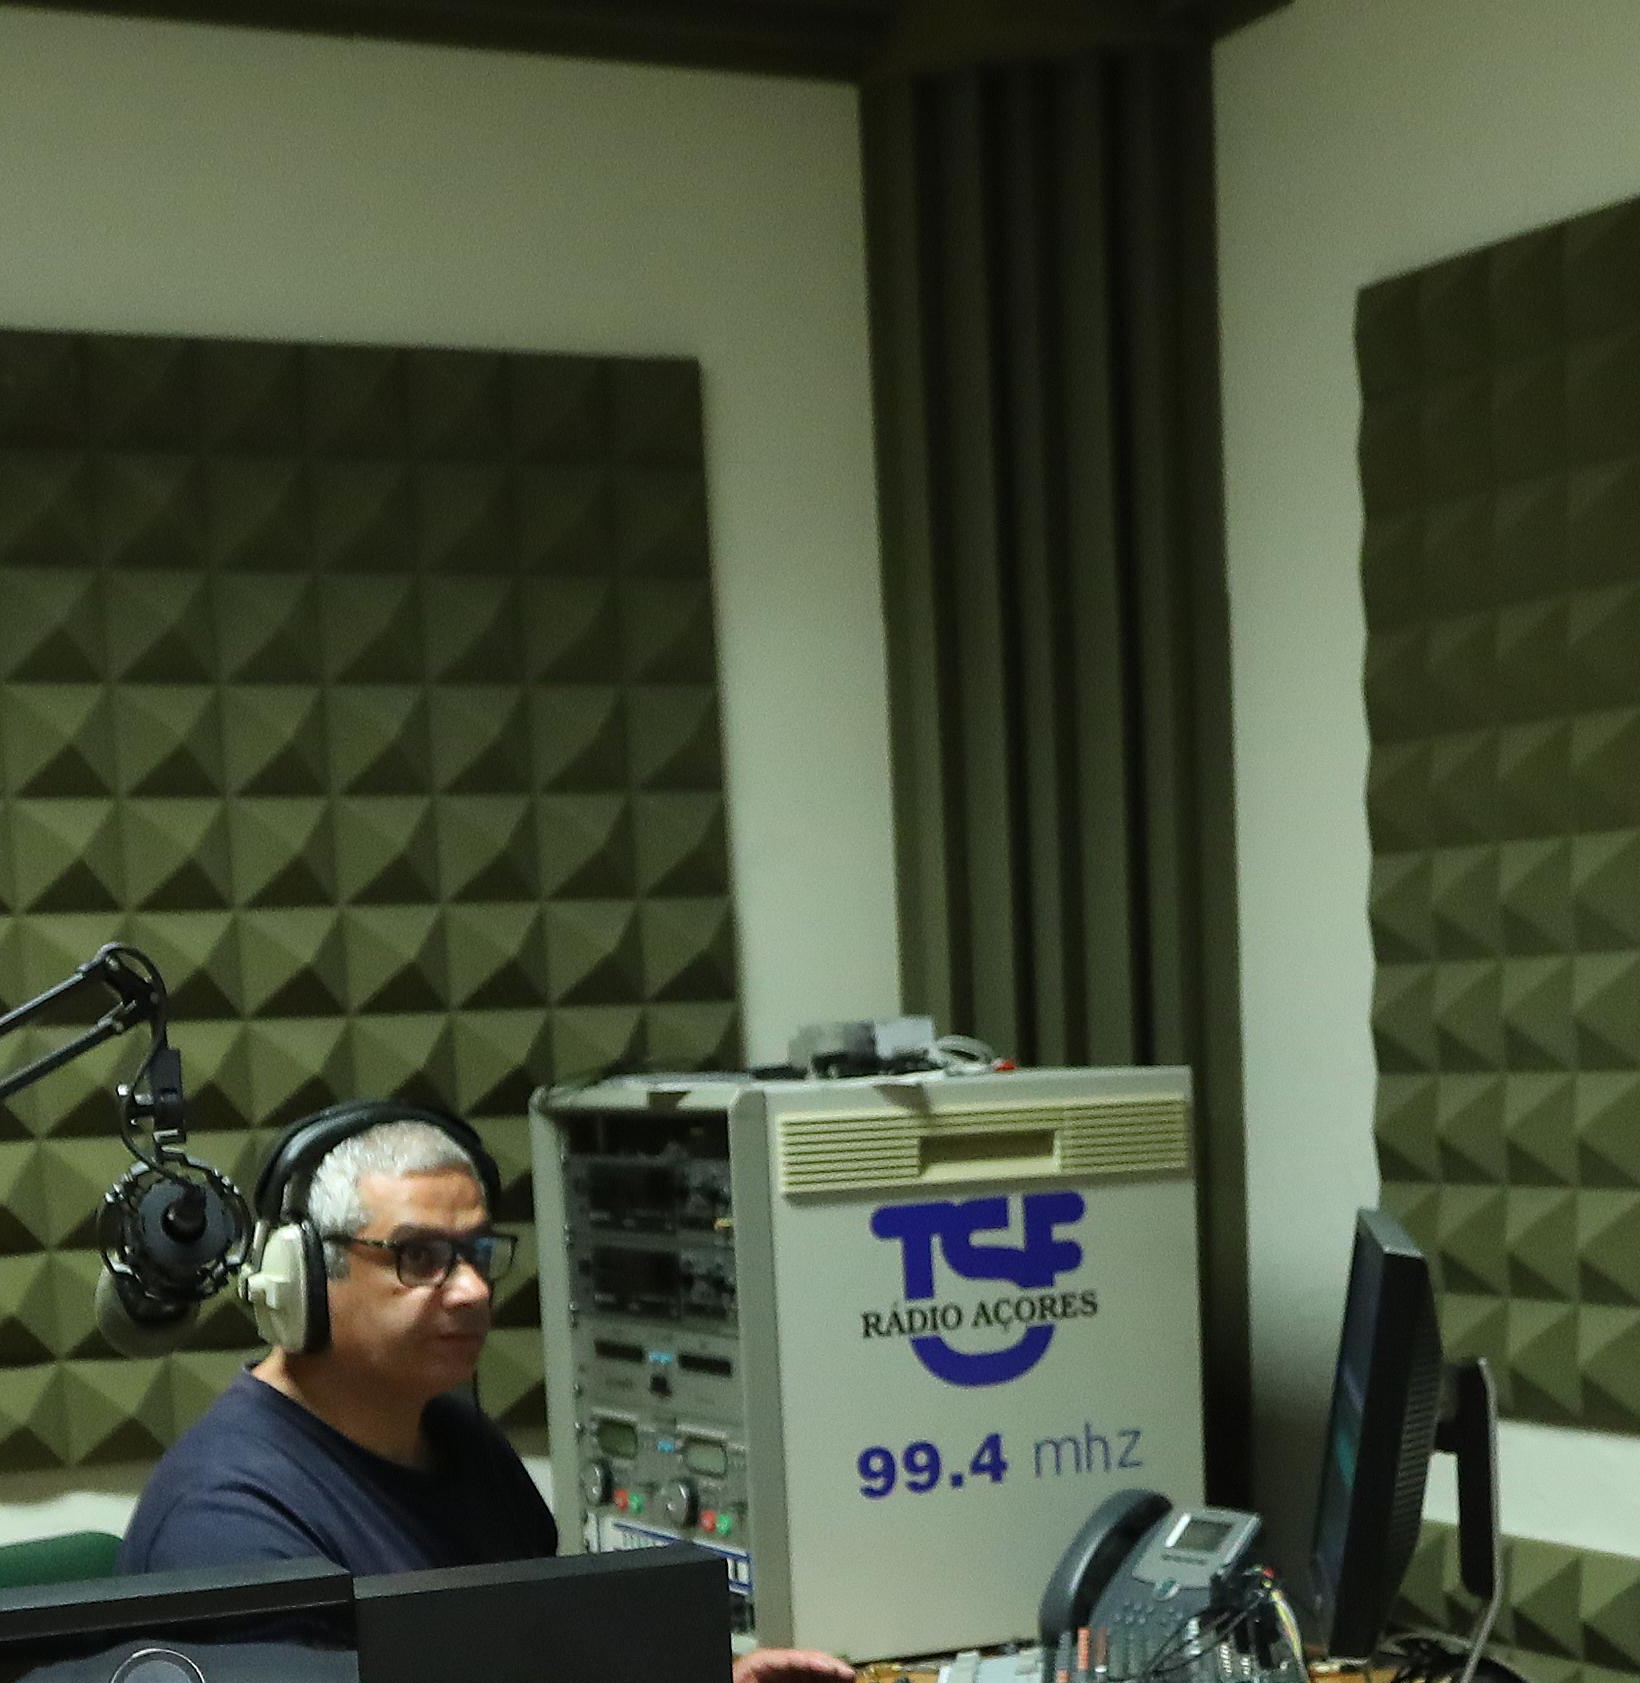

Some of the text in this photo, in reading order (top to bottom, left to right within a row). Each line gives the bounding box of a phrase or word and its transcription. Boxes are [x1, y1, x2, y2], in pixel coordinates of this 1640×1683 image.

[870, 1191, 1085, 1299] TSF
[861, 1289, 1100, 1340] RÁDIO AÇORES
[858, 1422, 1145, 1498] 99.4 mhz
